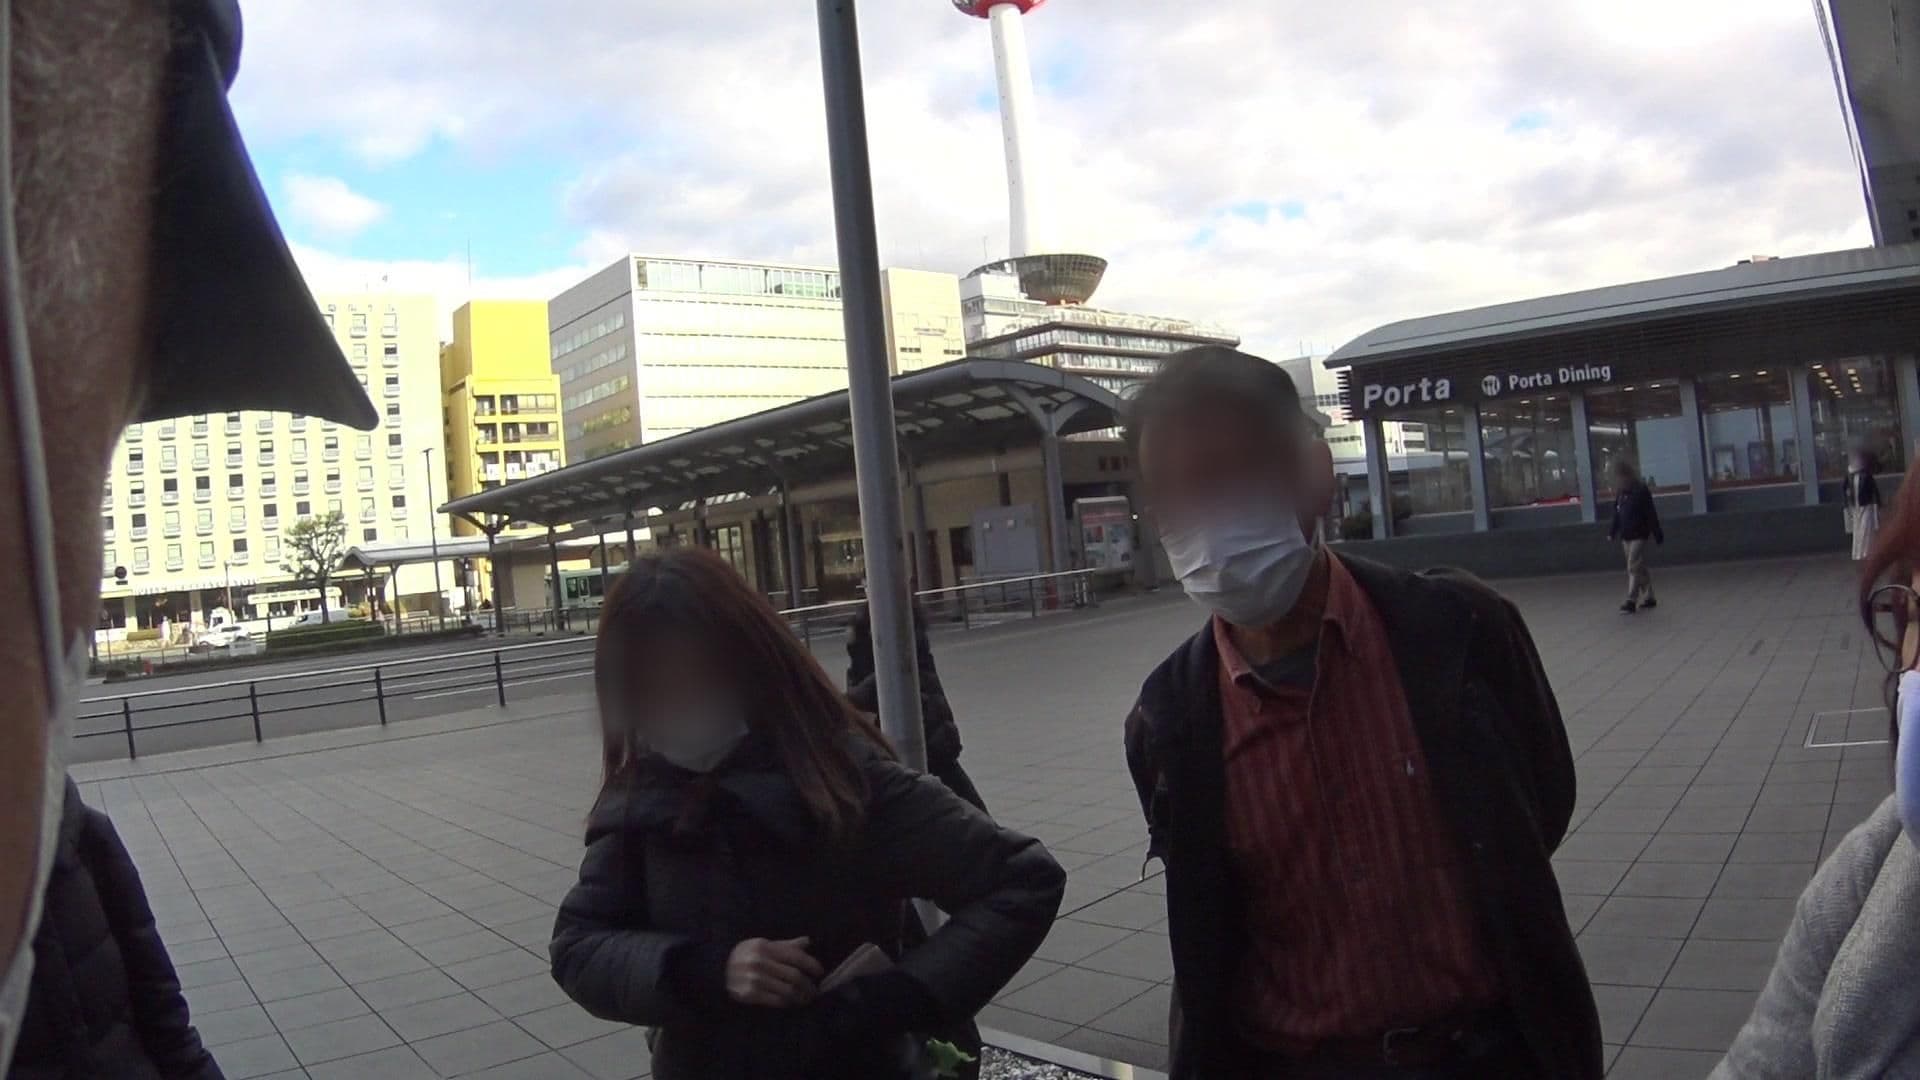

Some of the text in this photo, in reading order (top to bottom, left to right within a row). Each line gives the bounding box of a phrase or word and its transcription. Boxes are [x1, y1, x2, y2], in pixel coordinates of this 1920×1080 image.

[1509, 364, 1611, 390] Porta Dining
[1363, 377, 1450, 410] Porta
